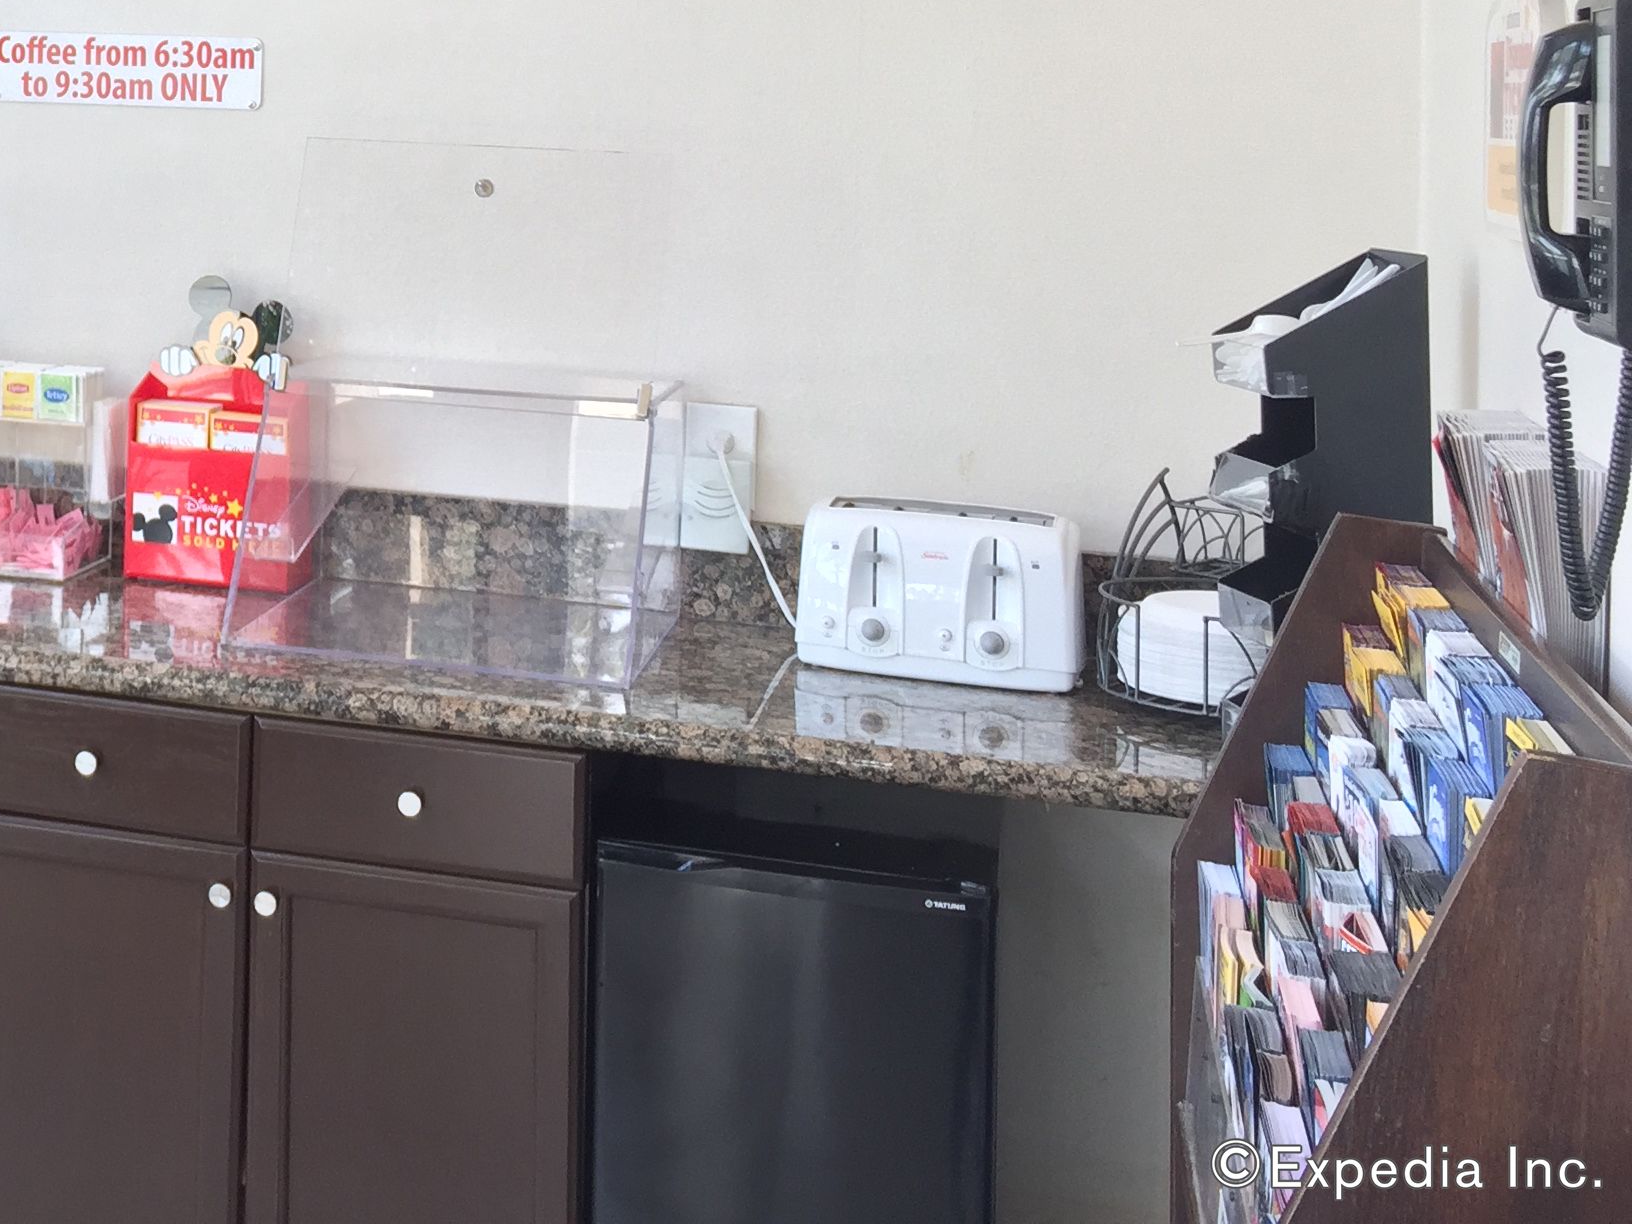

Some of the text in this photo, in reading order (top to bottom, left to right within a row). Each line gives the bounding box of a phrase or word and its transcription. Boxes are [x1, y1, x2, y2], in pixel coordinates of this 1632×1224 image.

[83, 37, 147, 67] from
[154, 40, 256, 70] 6:30am
[22, 70, 229, 103] to 9:30am ONLY
[182, 495, 226, 518] Disney
[181, 515, 282, 540] TICKETS
[183, 535, 225, 550] SOLD
